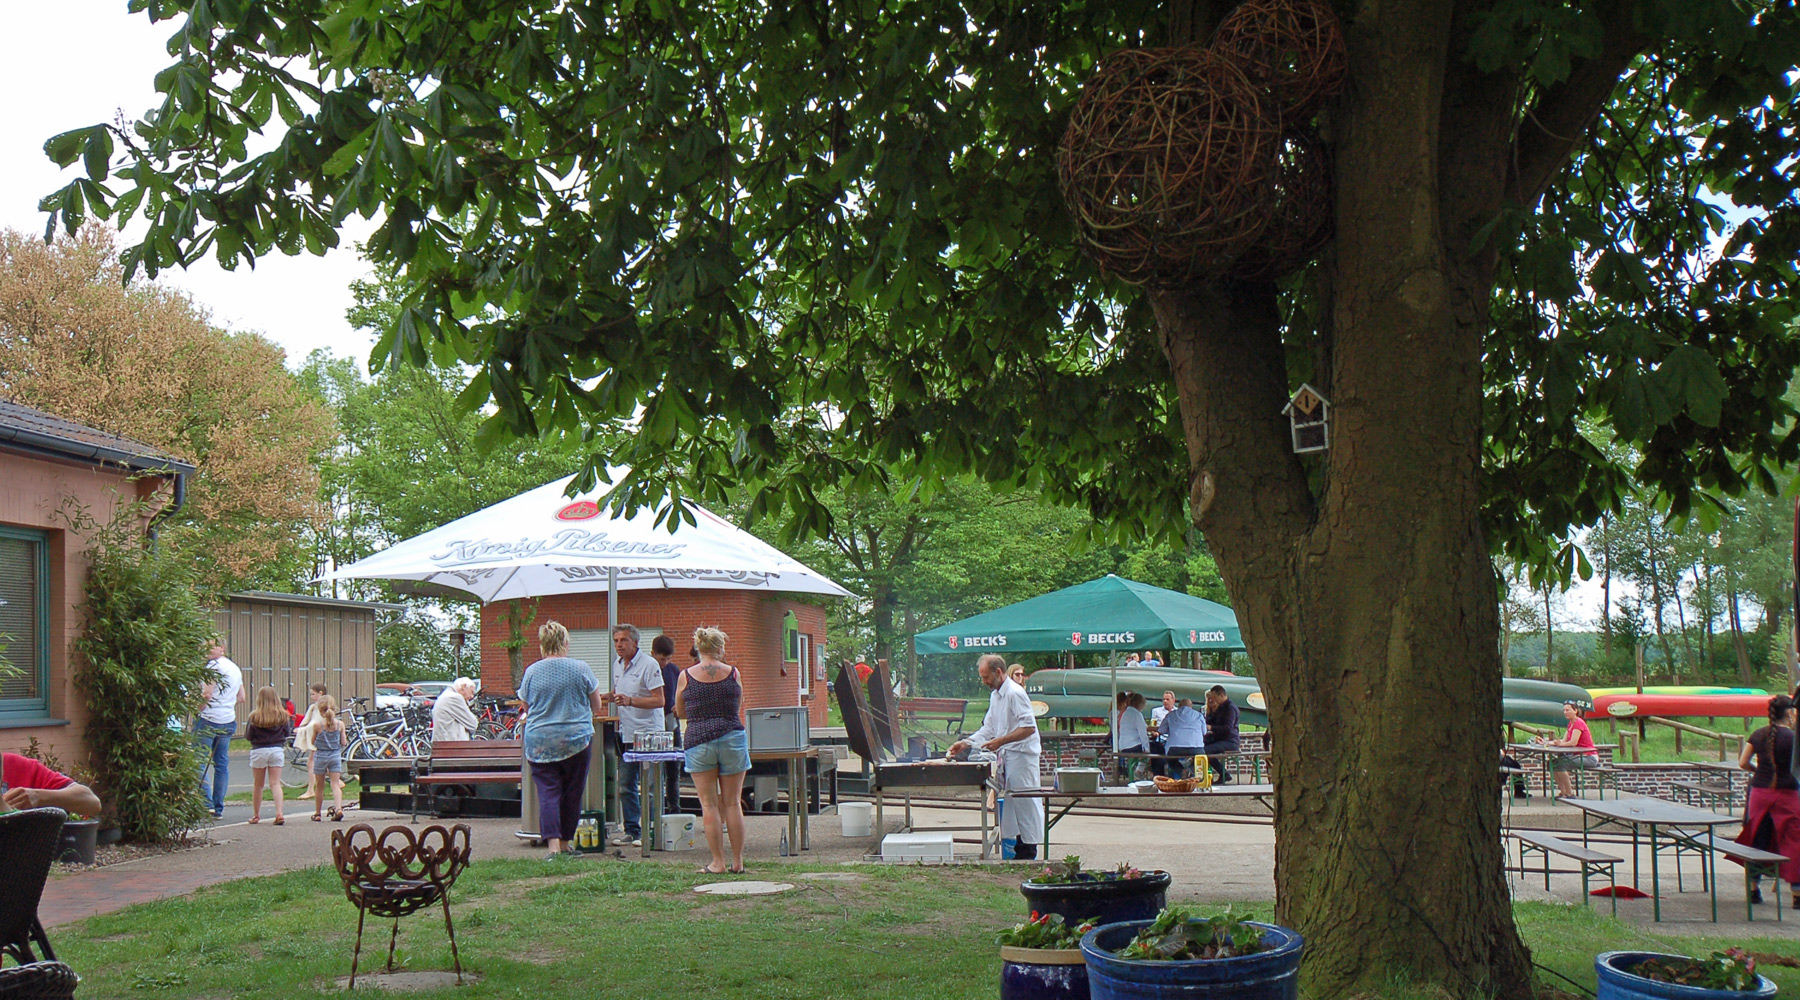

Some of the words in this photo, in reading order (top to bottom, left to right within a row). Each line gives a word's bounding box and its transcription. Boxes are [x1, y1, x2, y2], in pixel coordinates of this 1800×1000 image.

[542, 528, 688, 560] Pilsener
[964, 634, 1007, 647] BECK'S
[1088, 631, 1135, 644] BECK'S
[1199, 629, 1226, 642] BECK'S
